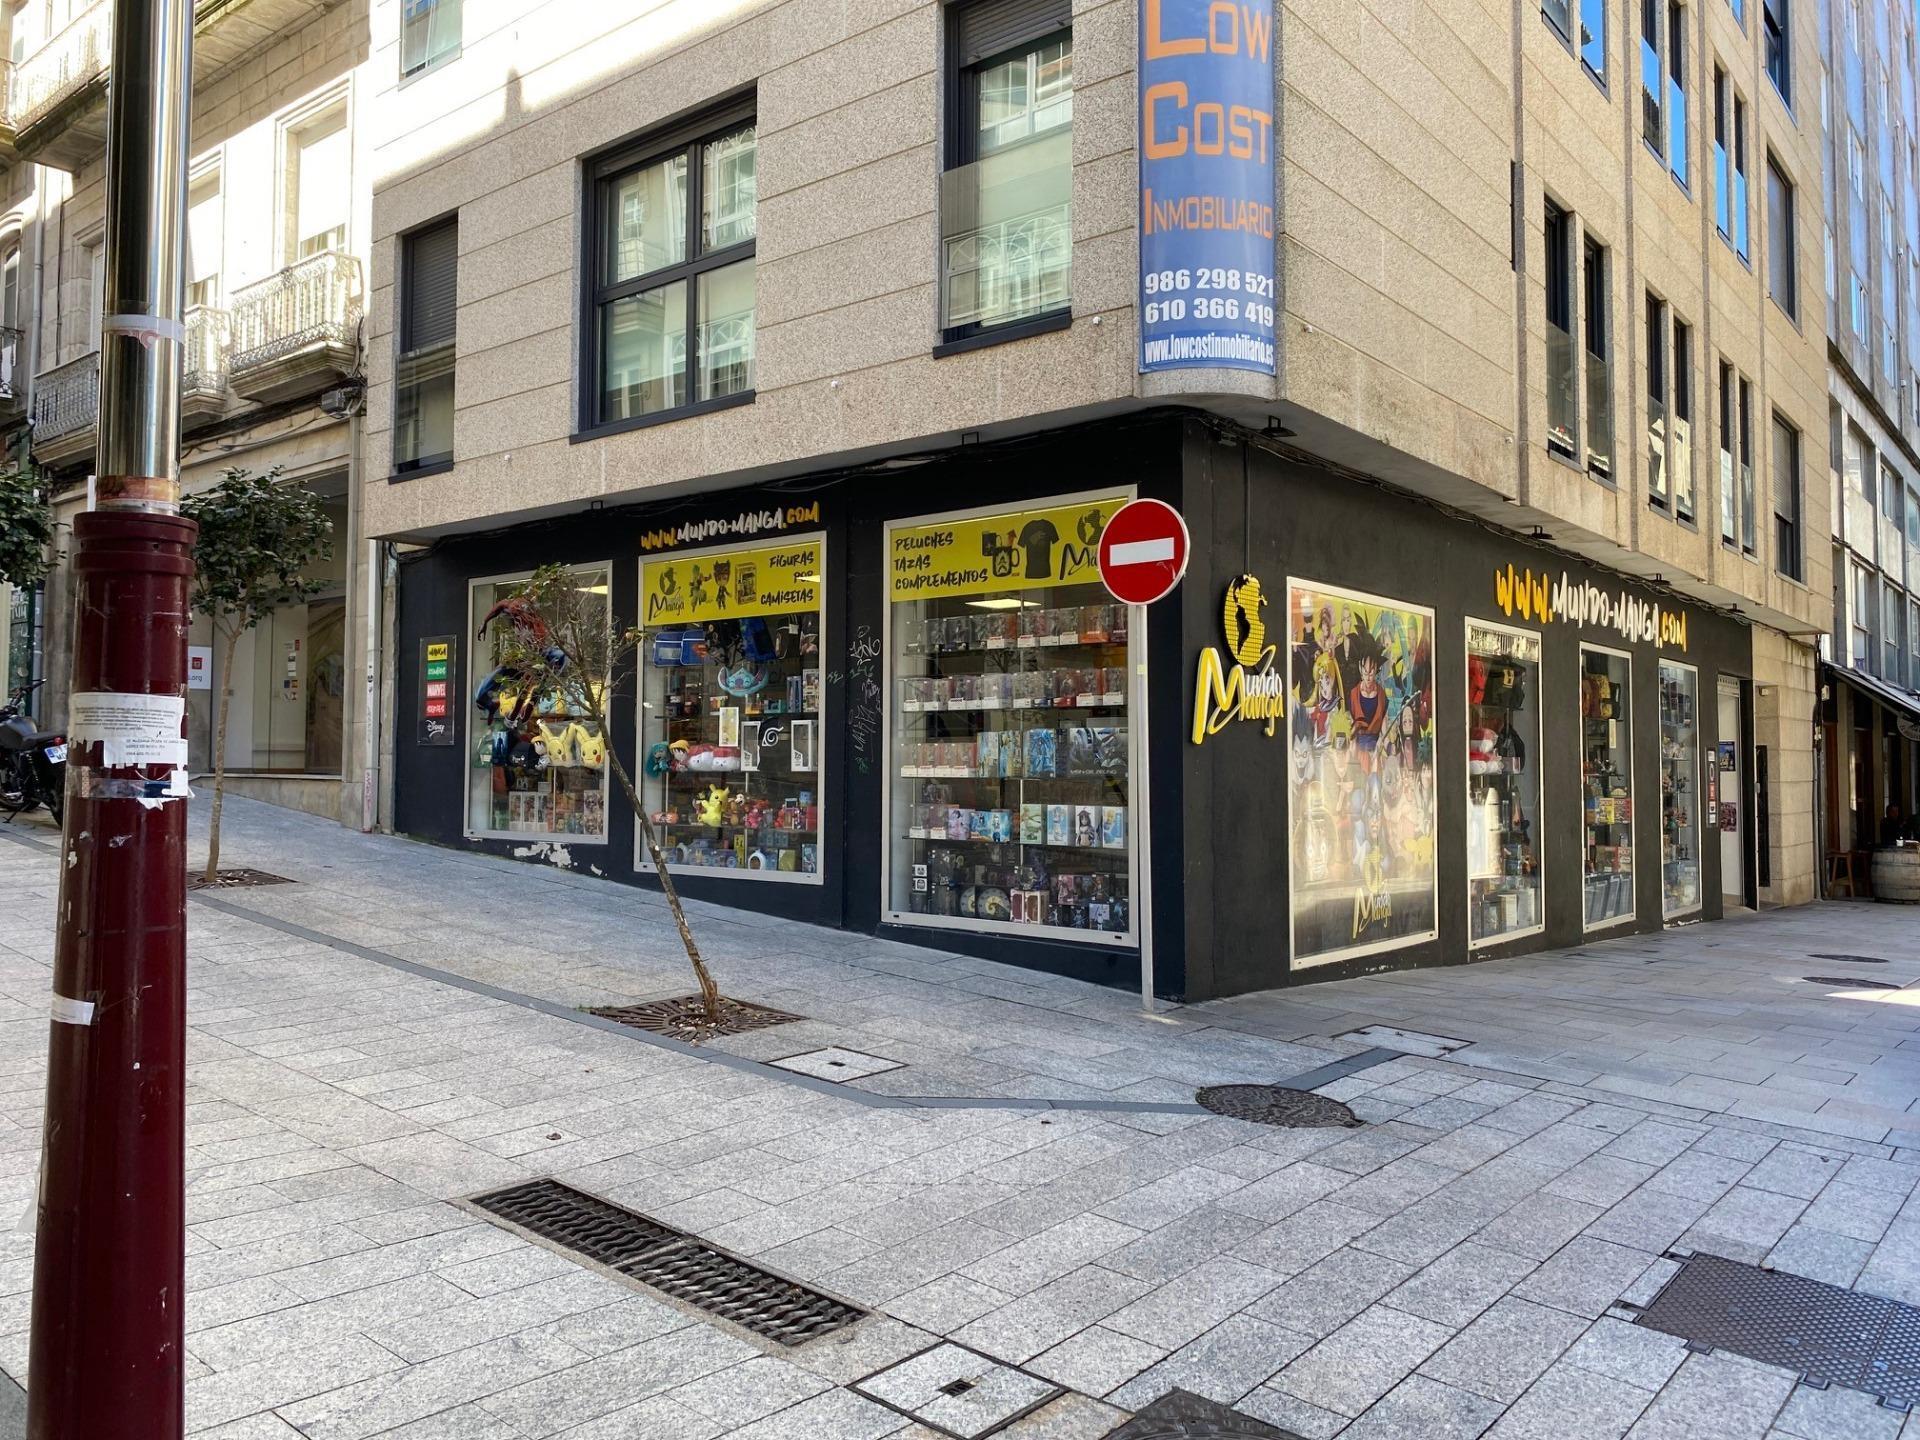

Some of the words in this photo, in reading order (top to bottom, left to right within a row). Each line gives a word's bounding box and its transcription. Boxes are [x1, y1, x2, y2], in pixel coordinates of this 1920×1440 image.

[1144, 81, 1272, 165] COST
[1144, 188, 1273, 239] INMOBILIARIO
[1145, 269, 1190, 294] 986
[1196, 268, 1240, 290] 298
[1245, 273, 1273, 299] 521
[1145, 299, 1185, 324] 610
[1193, 298, 1239, 321] 366
[1244, 302, 1274, 328] 419
[895, 532, 954, 551] PELUCHES
[895, 554, 931, 571] TAZAS
[895, 569, 988, 590] COMPLEMENTOS
